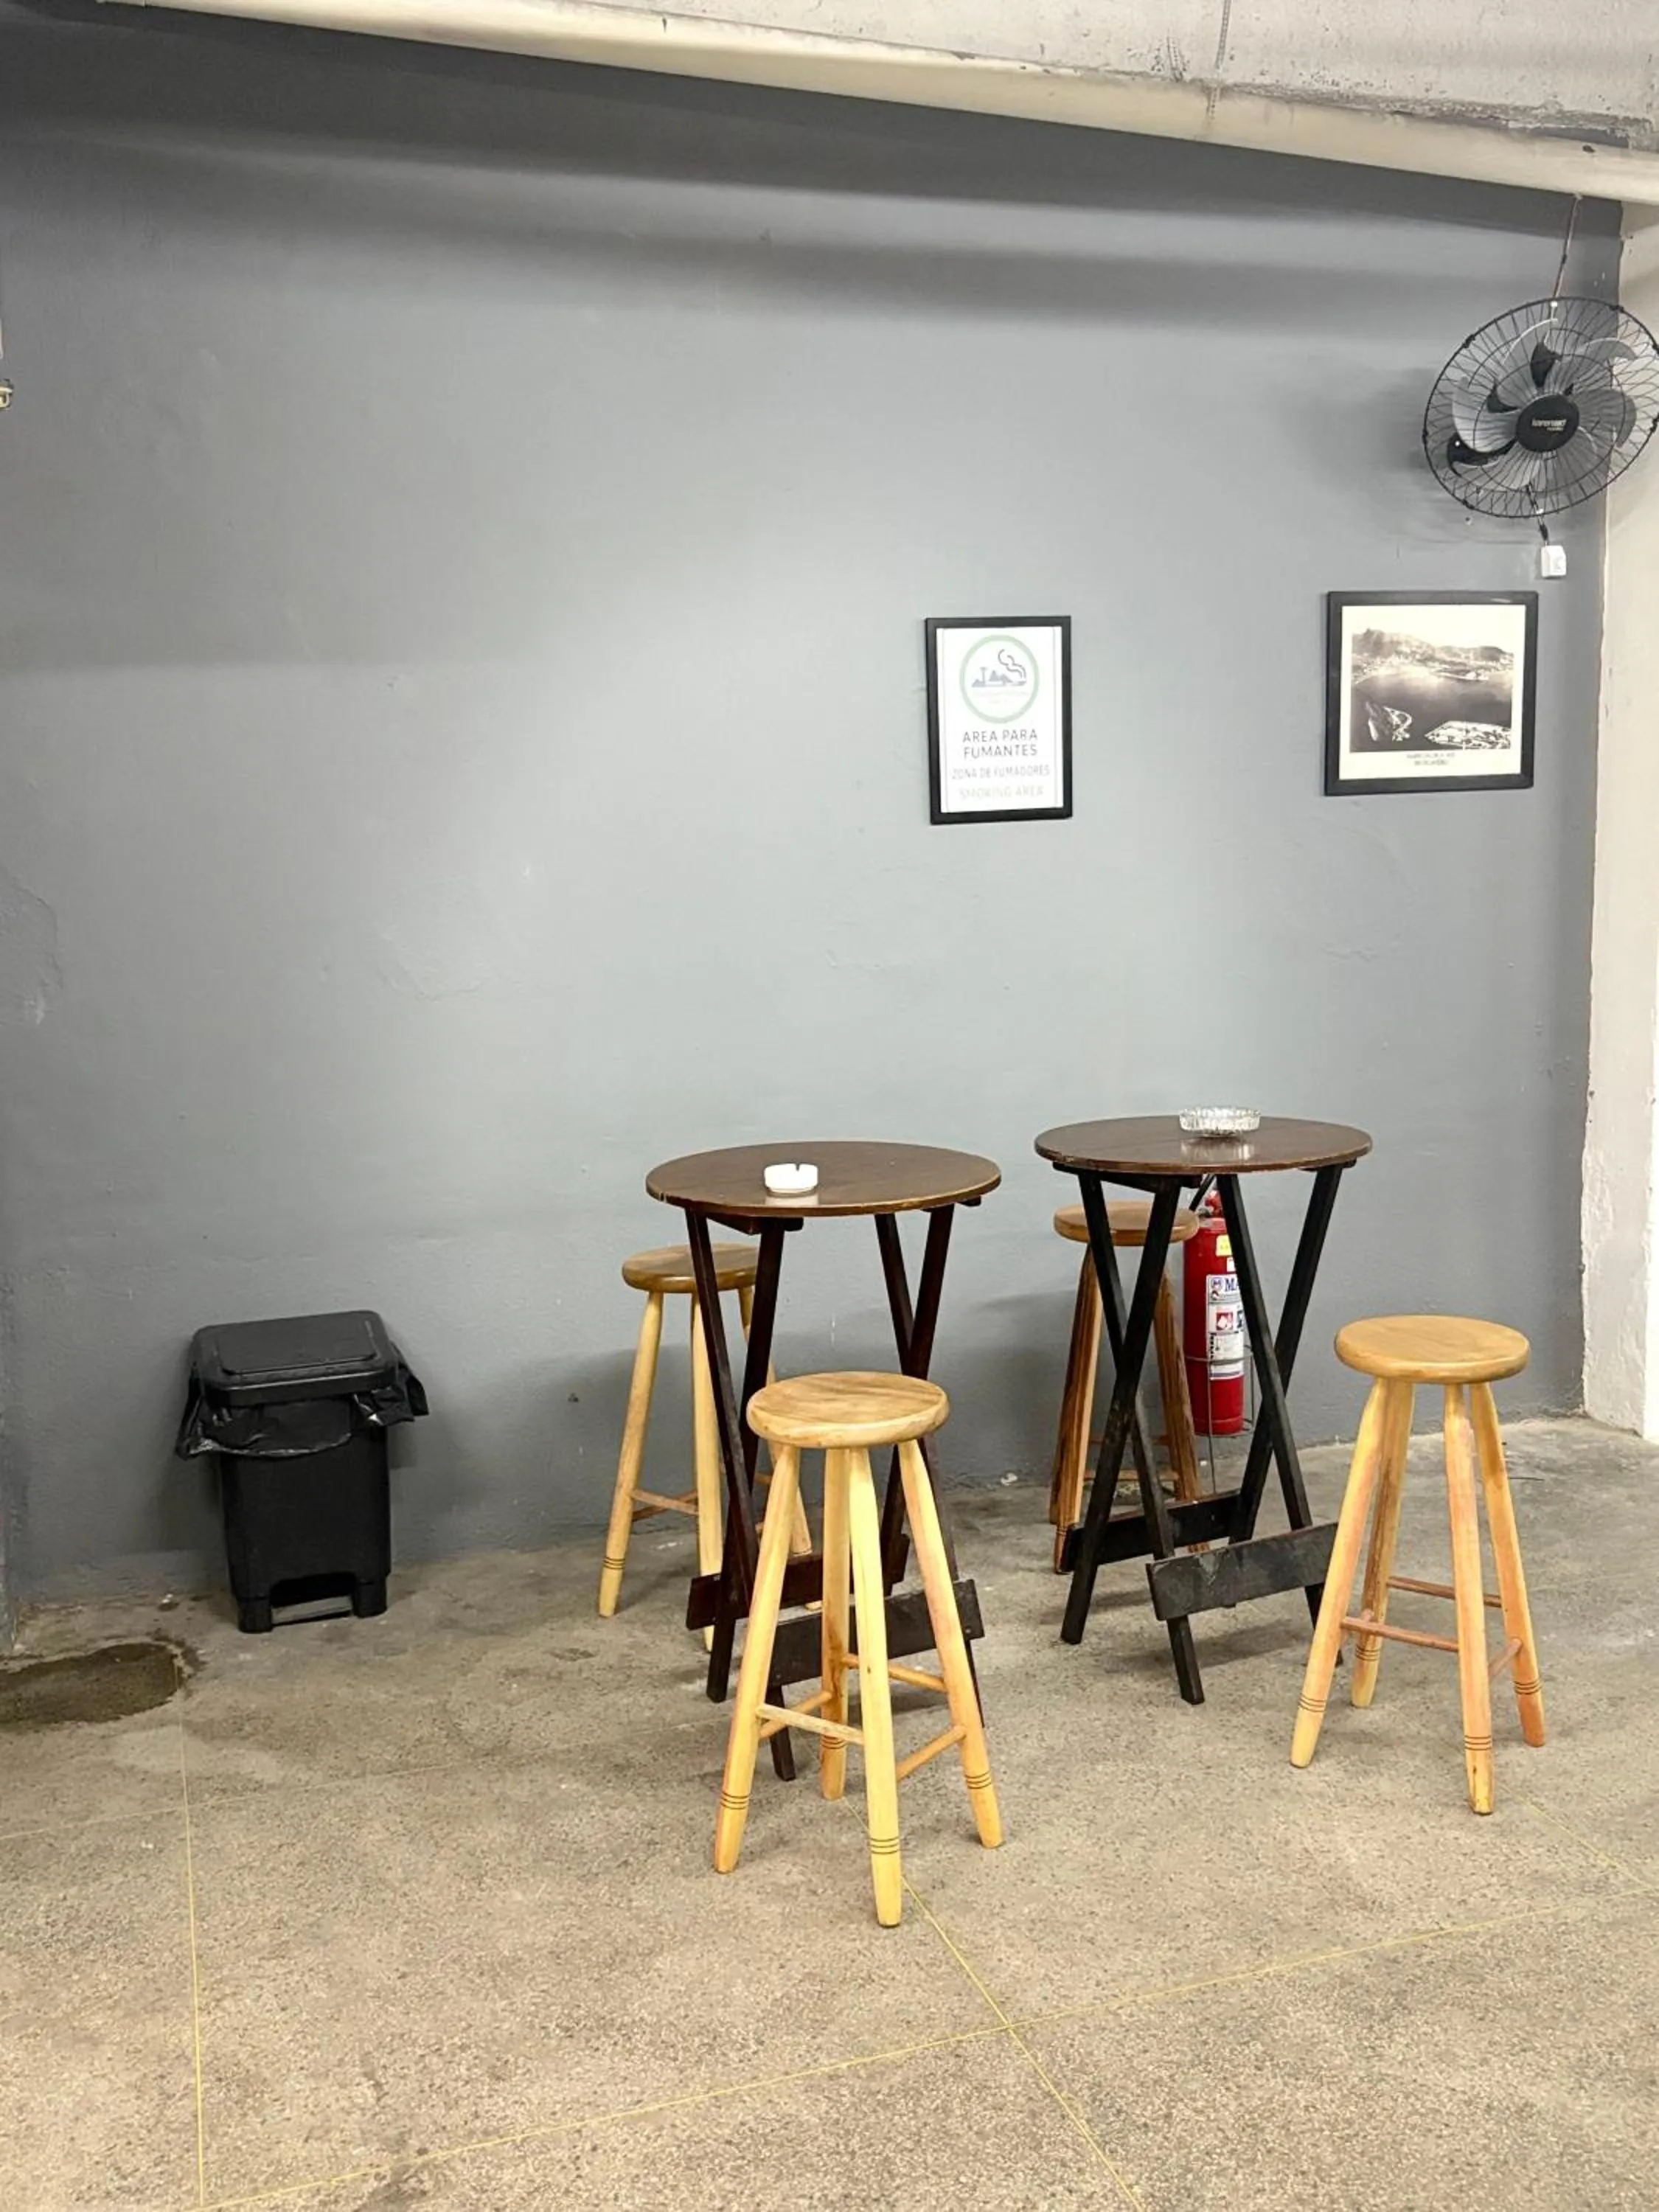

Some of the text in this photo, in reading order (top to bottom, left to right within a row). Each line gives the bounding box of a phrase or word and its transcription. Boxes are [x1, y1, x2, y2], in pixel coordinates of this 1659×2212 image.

[962, 728, 1038, 742] AREA PARA
[963, 744, 1038, 759] FUMANTES
[951, 764, 1050, 779] ZONA DE FUMADORES
[959, 785, 1044, 799] SMOKING AREA
